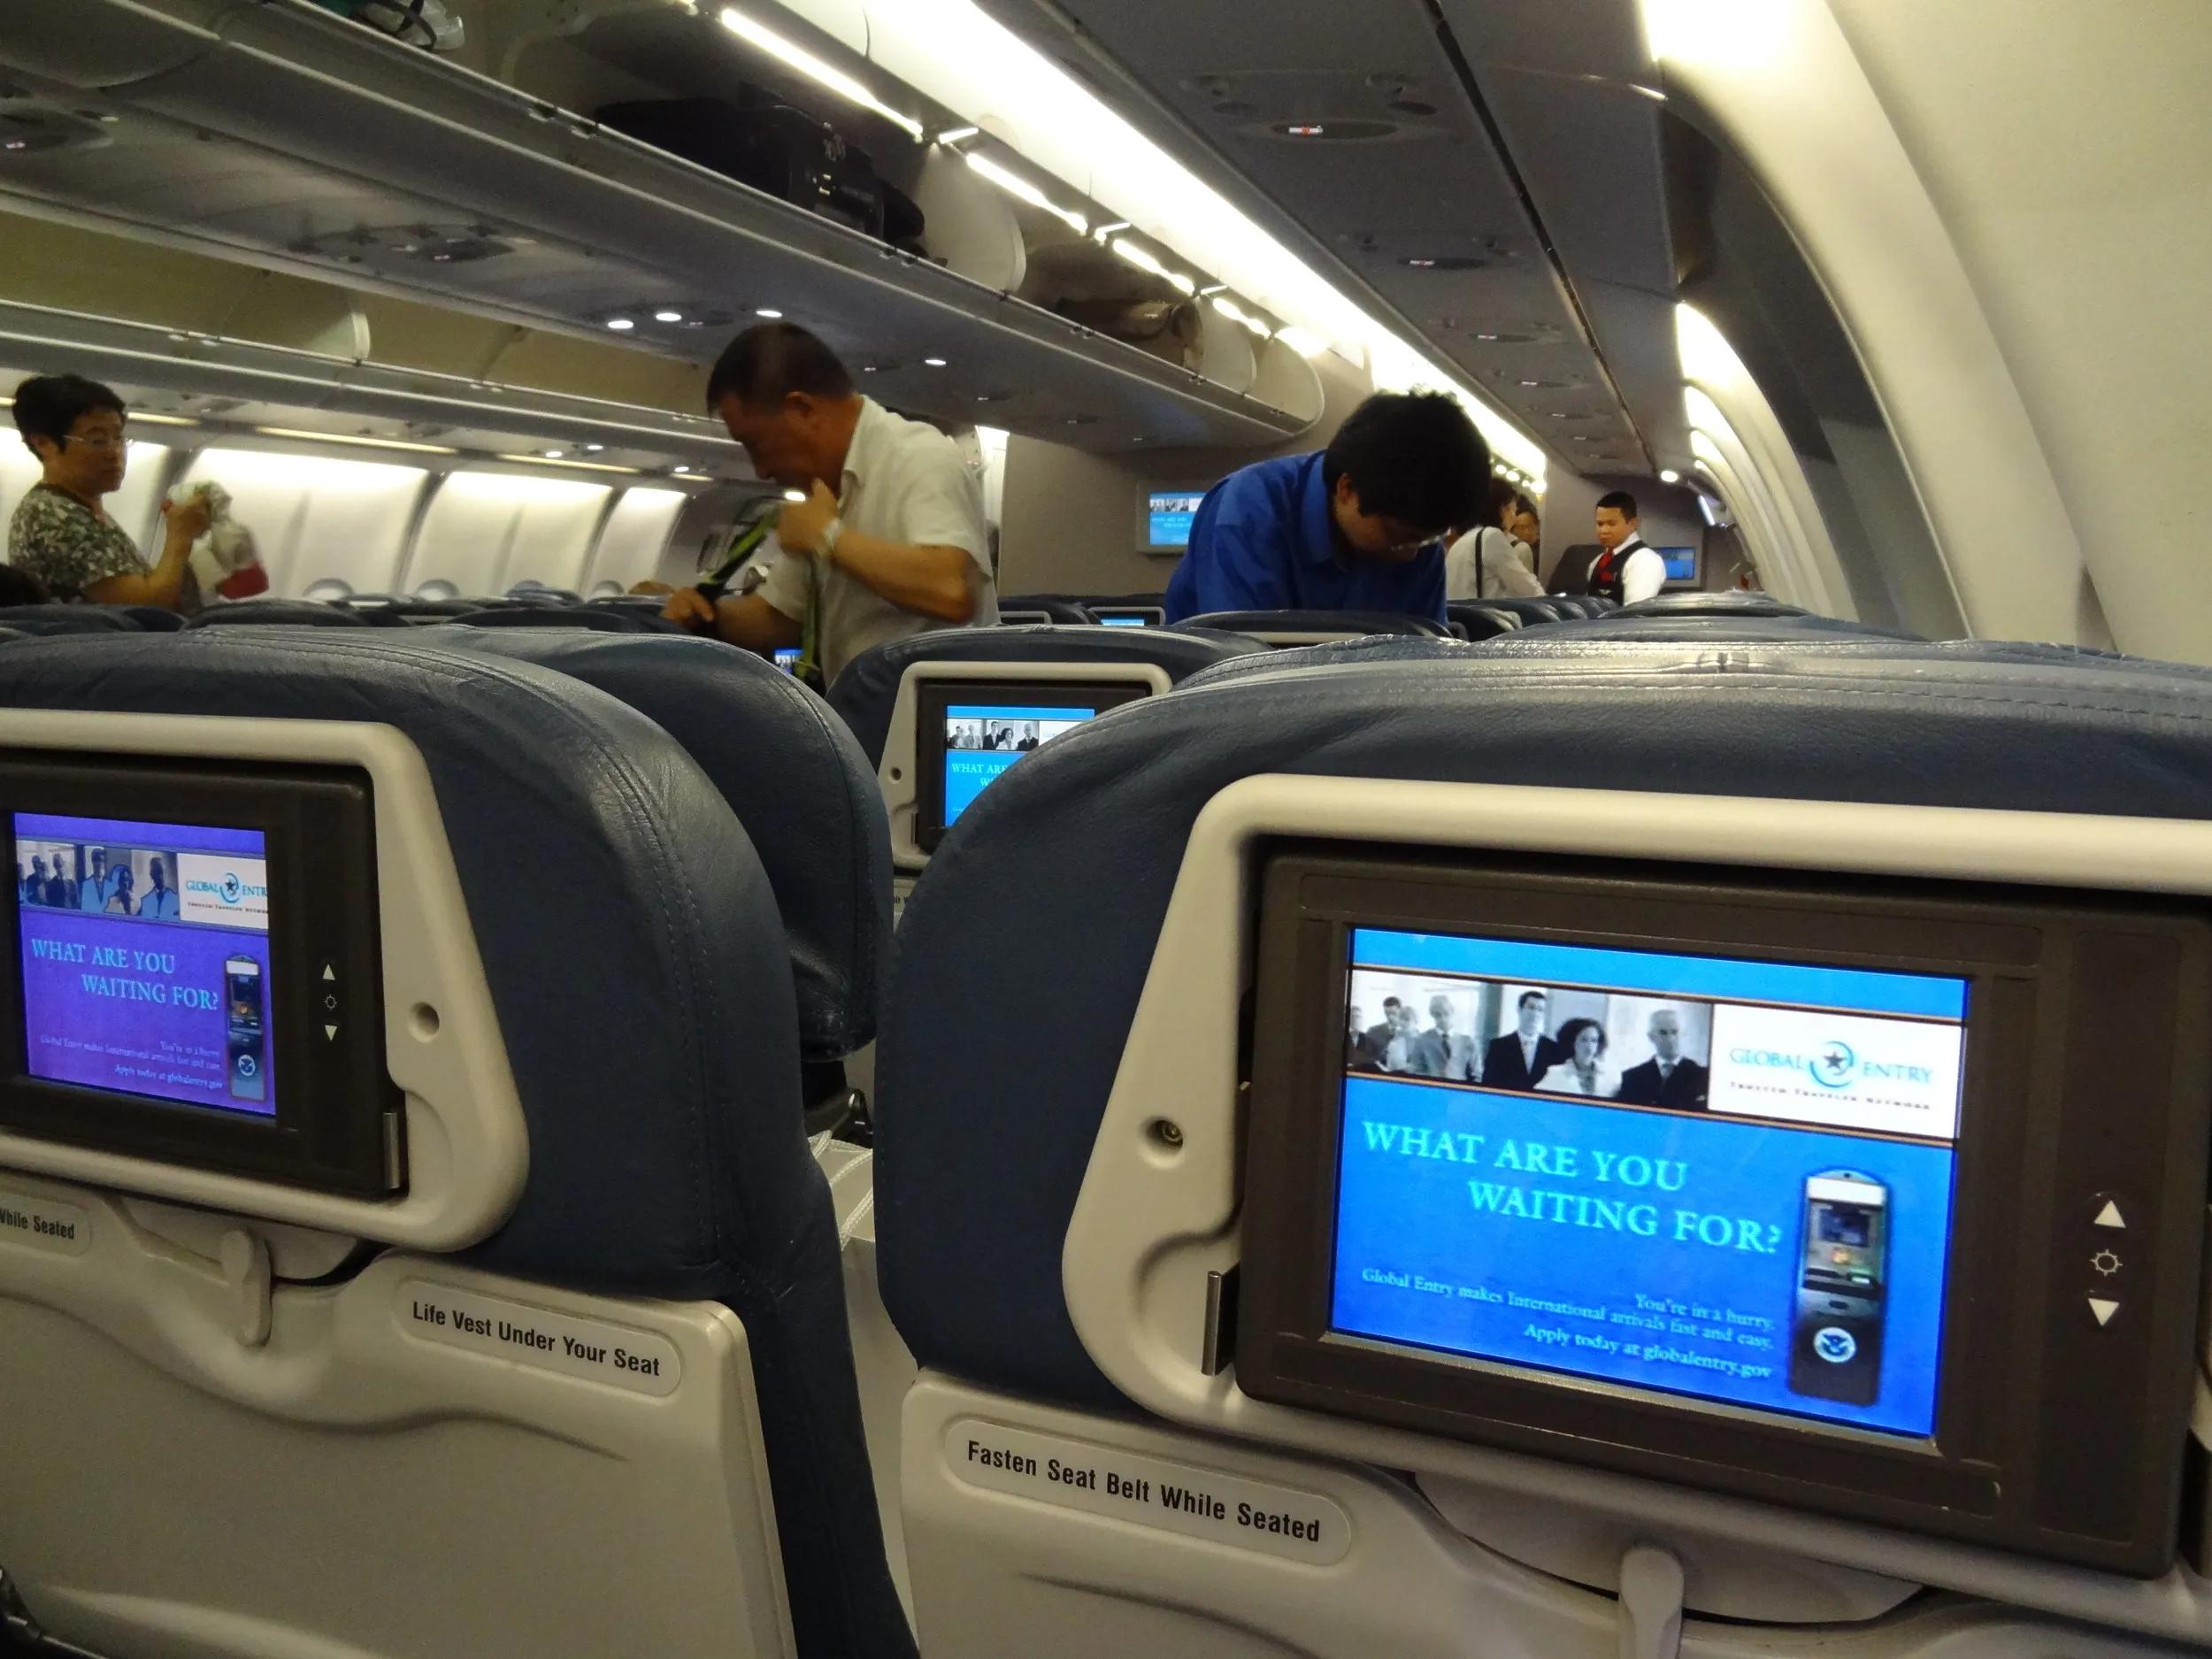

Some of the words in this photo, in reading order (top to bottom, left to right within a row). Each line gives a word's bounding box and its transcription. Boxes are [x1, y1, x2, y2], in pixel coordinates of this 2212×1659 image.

[952, 763, 984, 773] WHAT
[186, 880, 219, 893] GLOBAL
[242, 885, 268, 896] ENTR
[32, 939, 86, 963] WHAT
[92, 947, 128, 968] ARE
[134, 951, 175, 974] YOU
[81, 973, 166, 1003] WAITING
[173, 986, 219, 1010] FOR?
[1729, 1048, 1807, 1071] GLOBAL
[1863, 1062, 1934, 1084] ENTRY
[1363, 1121, 1485, 1163] WHAT
[1494, 1140, 1578, 1177] ARE
[1594, 1151, 1688, 1191] YOU
[34, 1216, 74, 1240] Seated
[1468, 1181, 1658, 1236] WAITING
[1674, 1210, 1782, 1253] FOR?
[1362, 1268, 1409, 1287] Global
[1415, 1276, 1453, 1298] Entry
[1458, 1286, 1503, 1302] makes
[1508, 1292, 1606, 1320] International
[1610, 1312, 1665, 1331] arrivals
[1671, 1319, 1697, 1336] fast
[1702, 1328, 1732, 1341] and
[1636, 1294, 1686, 1316] You're
[1692, 1302, 1708, 1318] in
[1713, 1310, 1722, 1321] a
[413, 1301, 445, 1325] Life
[452, 1310, 492, 1337] Vest
[498, 1321, 556, 1352] Under
[563, 1335, 606, 1363] Your
[614, 1348, 659, 1376] Seat
[1524, 1324, 1571, 1346] Apply
[1575, 1334, 1619, 1355] today
[1624, 1344, 1640, 1356] at
[1642, 1345, 1771, 1378] globalentry.gov
[968, 1440, 1037, 1477] Fasten
[1048, 1459, 1095, 1490] Seat
[1107, 1472, 1149, 1502] Belt
[1161, 1484, 1225, 1520] While
[1237, 1502, 1320, 1542] Seated
